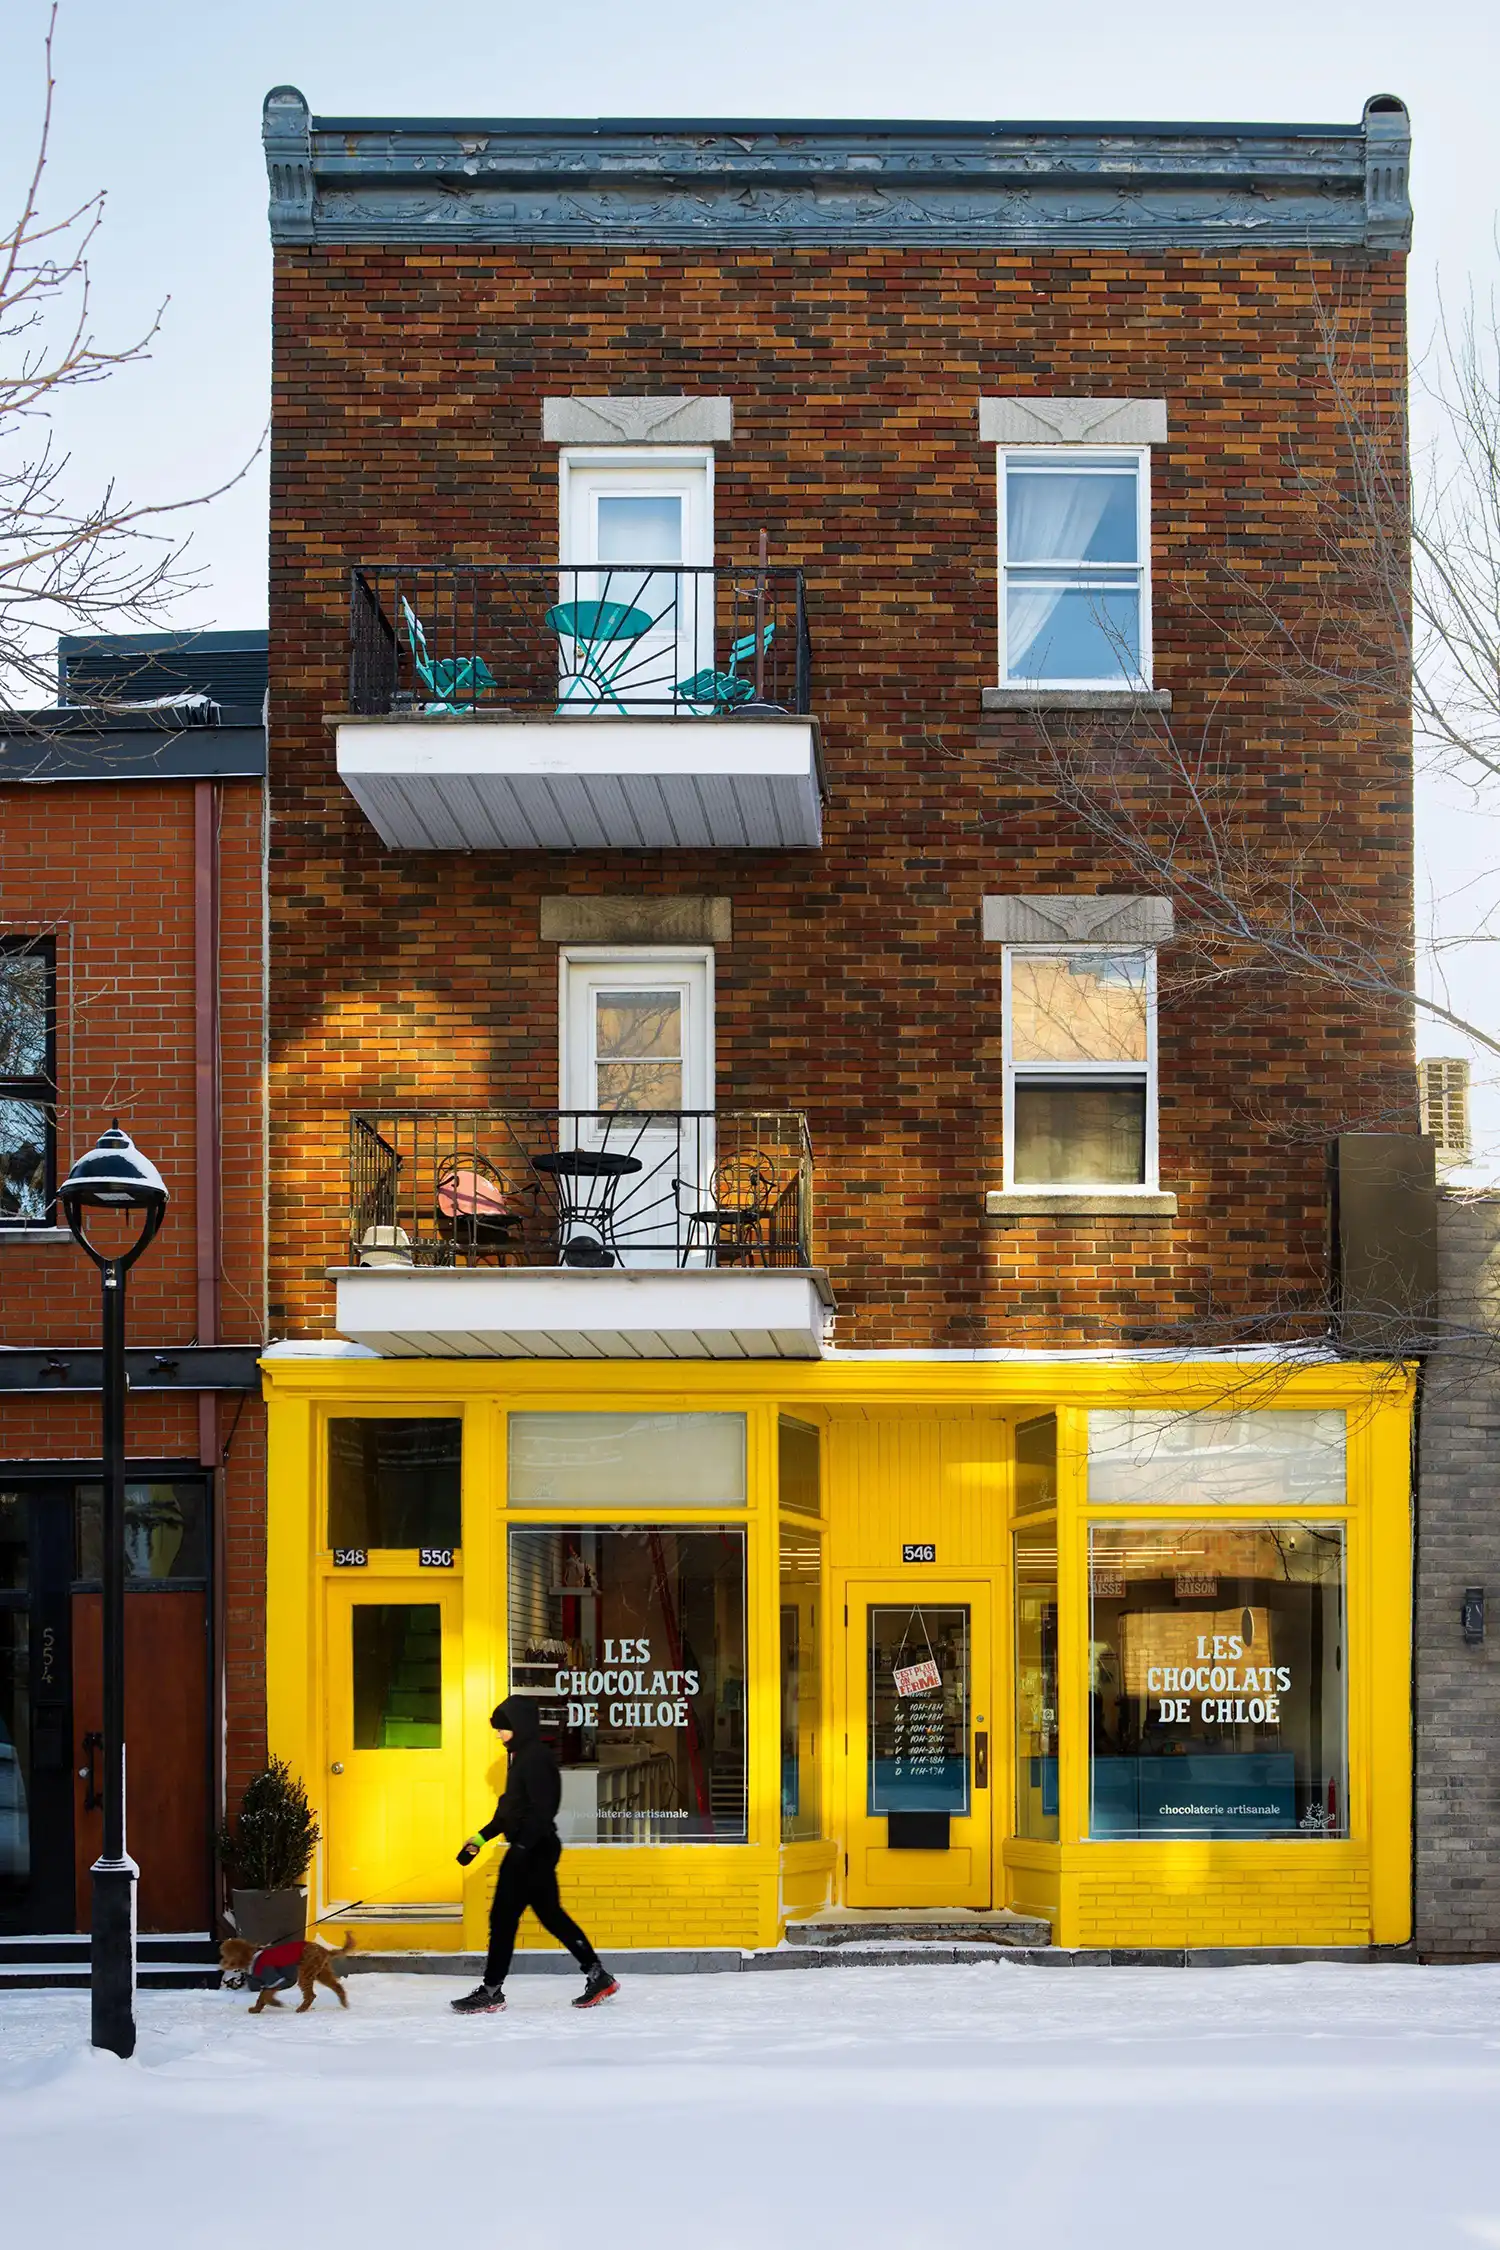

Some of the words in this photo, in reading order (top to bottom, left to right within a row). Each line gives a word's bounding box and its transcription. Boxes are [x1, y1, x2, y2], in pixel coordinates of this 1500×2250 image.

[335, 1549, 367, 1566] 548
[421, 1549, 451, 1566] 550
[904, 1546, 933, 1560] 546
[1177, 1582, 1216, 1594] SAISON
[41, 1627, 55, 1683] 554
[604, 1639, 651, 1664] LES
[1196, 1635, 1243, 1660] LES
[555, 1670, 700, 1696] CHOCOLATS
[1147, 1666, 1292, 1692] CHOCOLATS
[566, 1702, 599, 1727] DE
[609, 1697, 689, 1727] CHLOÉ
[910, 1703, 944, 1711] 10H-18H
[1158, 1698, 1191, 1723] DE
[1201, 1693, 1280, 1723] CHLOÉ
[910, 1713, 944, 1721] 10H-18H
[634, 1808, 689, 1819] artisanale
[1159, 1804, 1224, 1815] chocolaterie
[1227, 1804, 1280, 1815] artisanale
